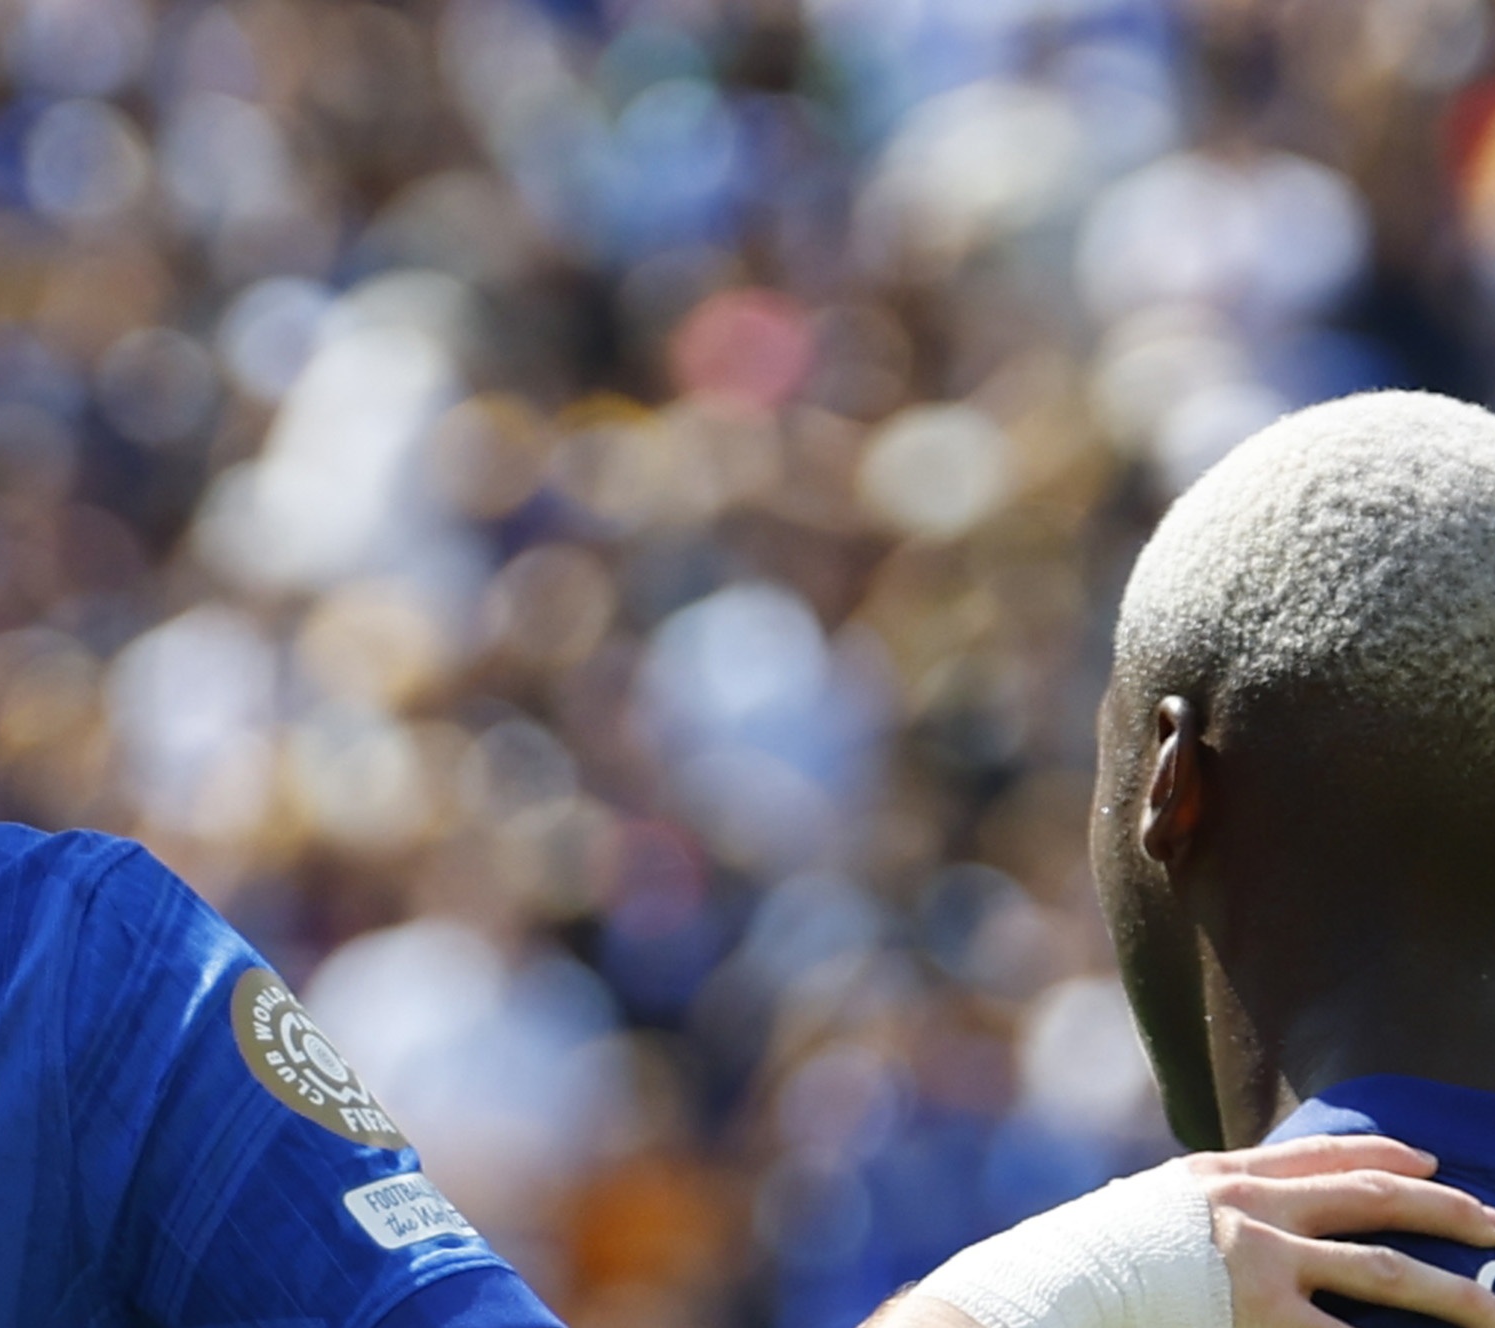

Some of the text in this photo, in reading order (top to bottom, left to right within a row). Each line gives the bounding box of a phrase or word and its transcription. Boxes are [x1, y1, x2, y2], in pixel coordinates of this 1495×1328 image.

[252, 985, 398, 1135] FIFA CLUB WORLD
